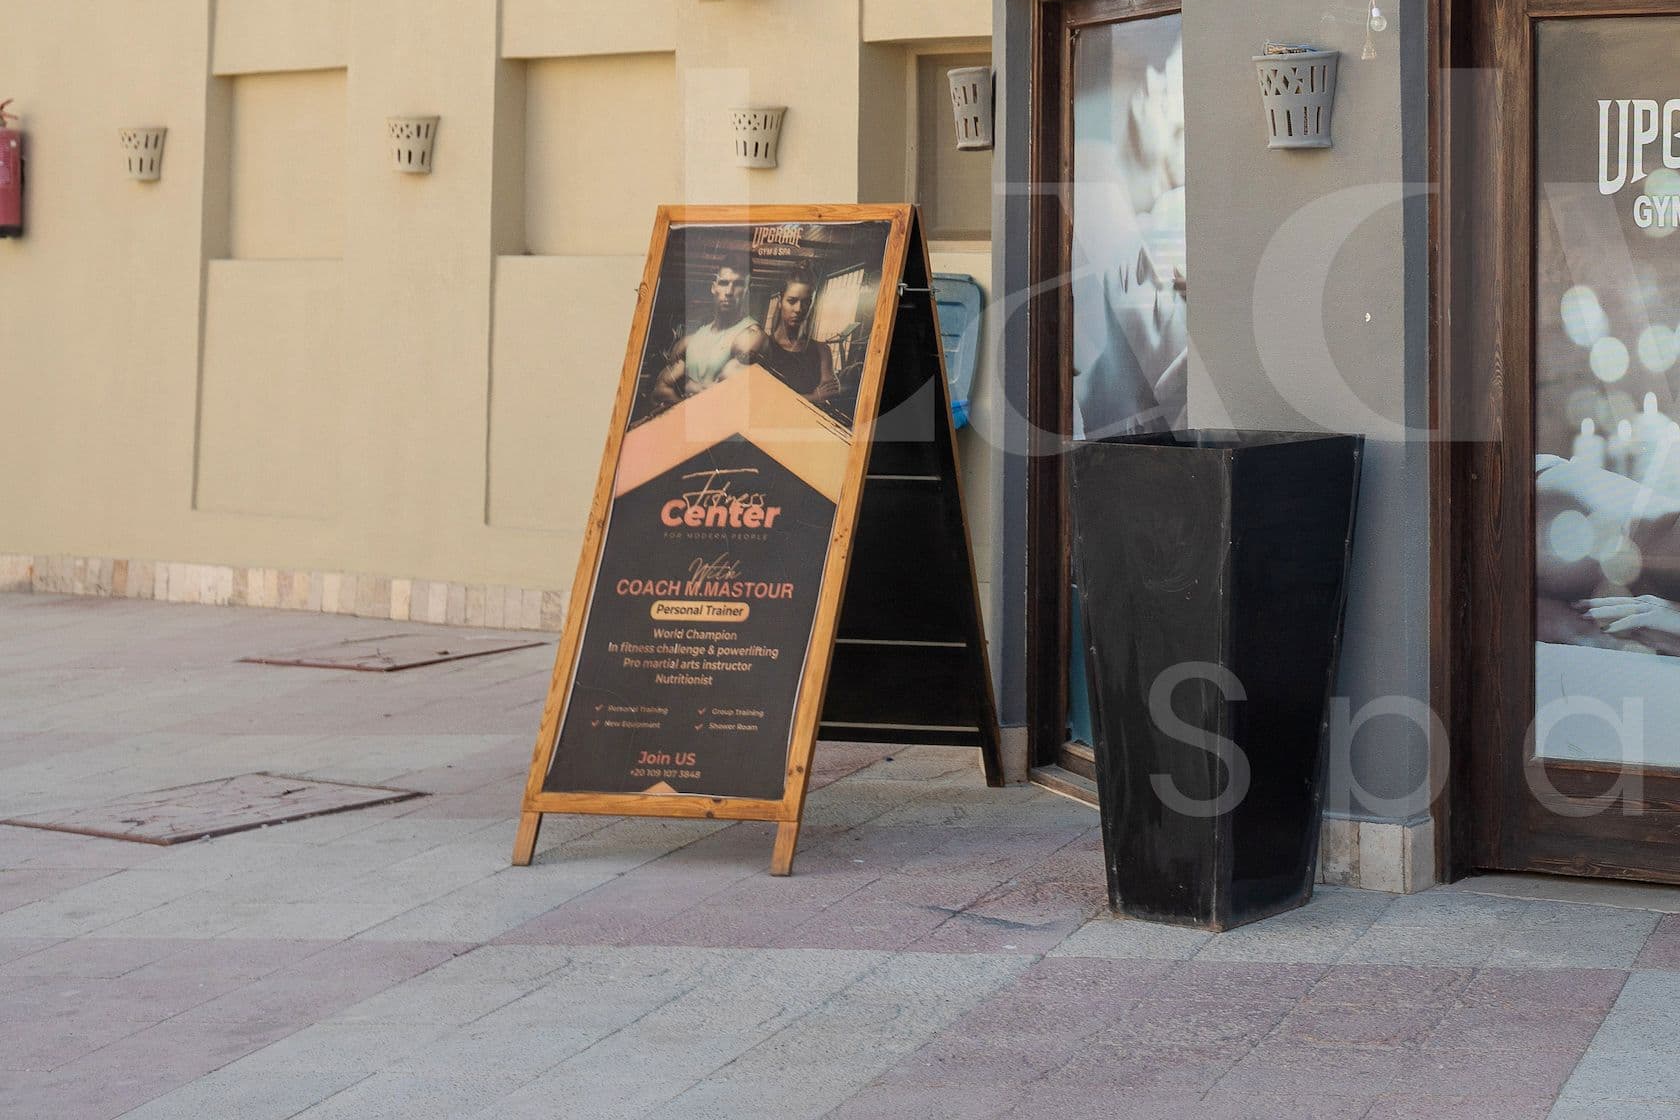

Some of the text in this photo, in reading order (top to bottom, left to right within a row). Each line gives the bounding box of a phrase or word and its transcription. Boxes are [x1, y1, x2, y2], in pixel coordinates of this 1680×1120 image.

[752, 226, 804, 249] UPGRADE
[661, 499, 781, 528] Center
[616, 580, 681, 596] COACH
[656, 604, 744, 617] Personal Trainer
[653, 629, 737, 643] World Champion
[608, 642, 779, 660] In fitness challenge & powerlifting
[623, 658, 752, 671] Pro martial arts instructor
[655, 674, 713, 685] Nutritionist
[638, 750, 697, 766] Join US
